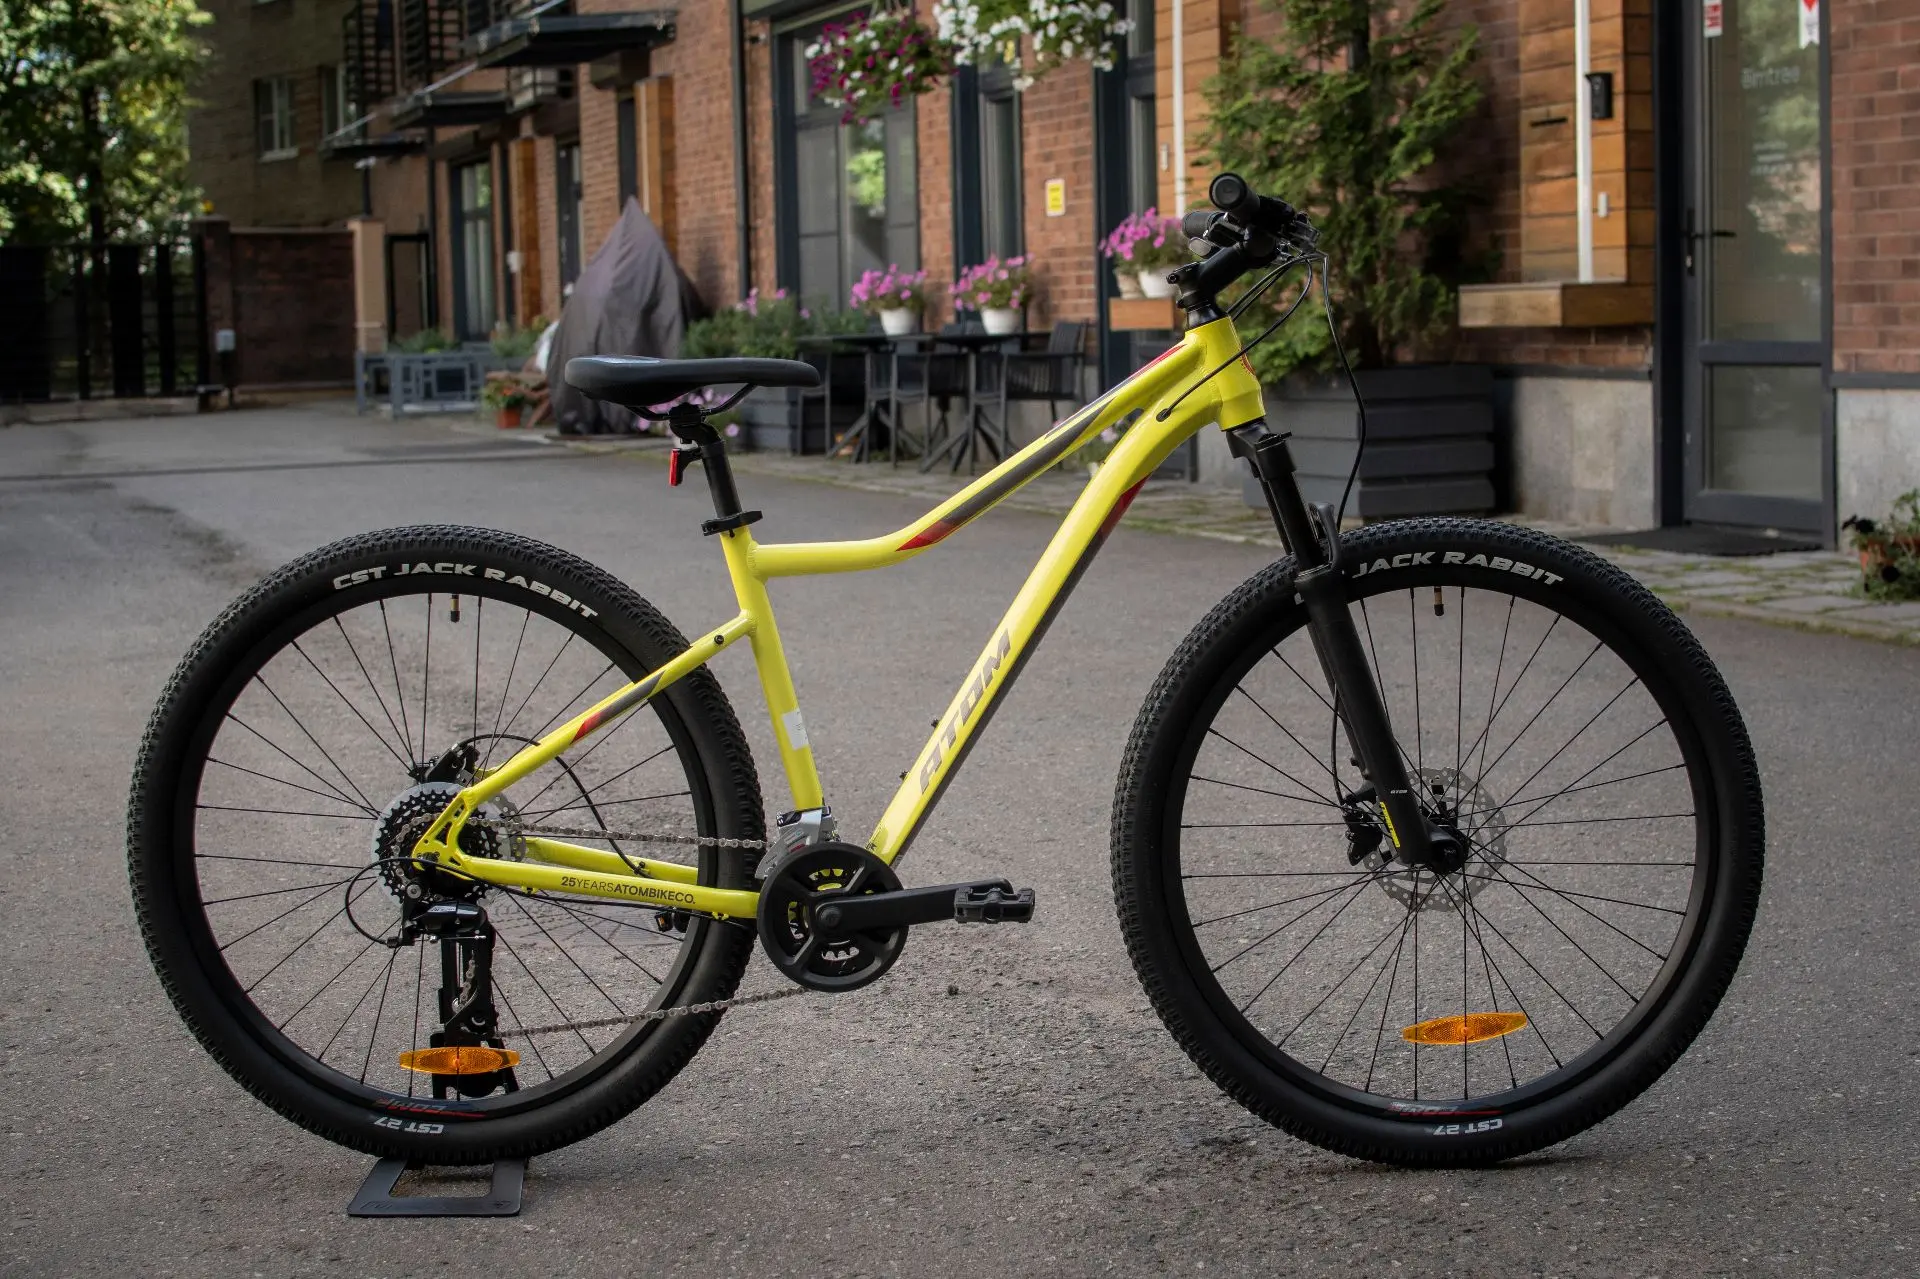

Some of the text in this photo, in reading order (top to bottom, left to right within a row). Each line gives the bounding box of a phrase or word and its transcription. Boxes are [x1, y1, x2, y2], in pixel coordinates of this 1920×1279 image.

[1352, 551, 1564, 585] JACK RABBIT
[333, 562, 598, 618] CST JACK RABBIT
[920, 628, 1011, 794] ATOM
[404, 1122, 444, 1134] CST
[1465, 1118, 1503, 1134] CST
